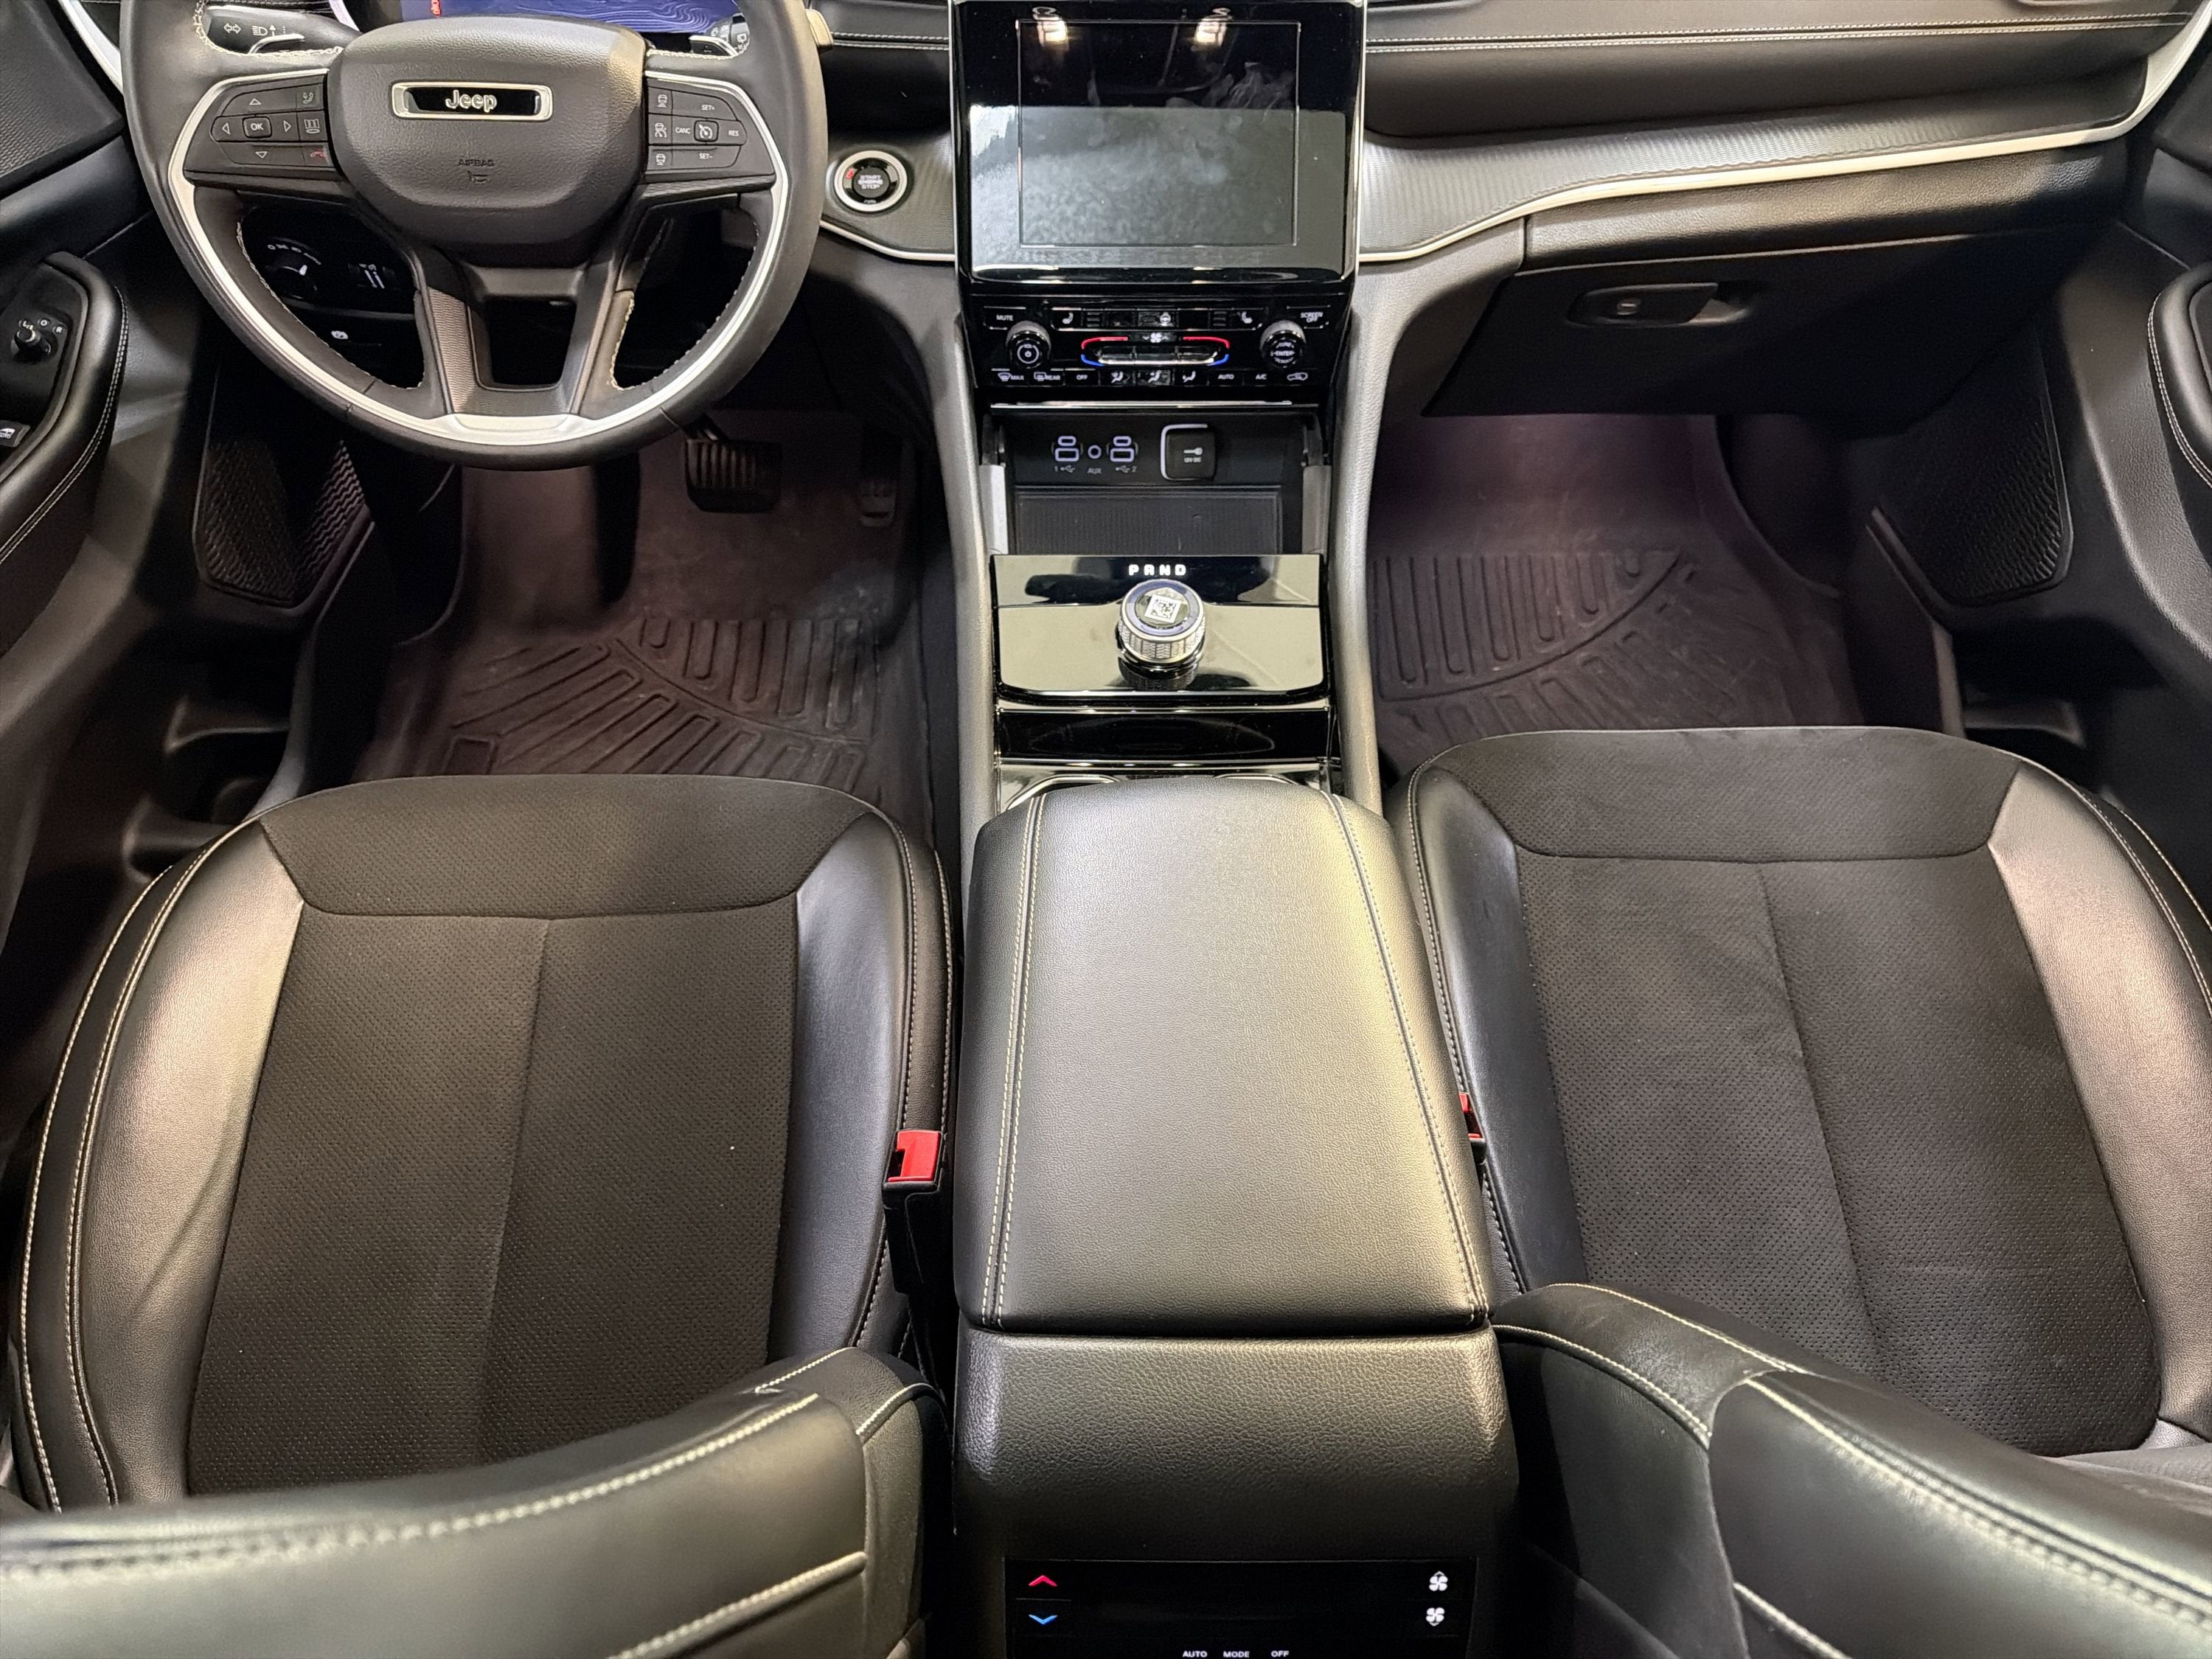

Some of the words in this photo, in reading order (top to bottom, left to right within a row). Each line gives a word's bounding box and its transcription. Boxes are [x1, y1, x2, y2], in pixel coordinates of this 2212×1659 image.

[445, 89, 497, 112] Jeep
[250, 122, 265, 131] OK
[458, 159, 495, 167] AIRBAG
[1087, 467, 1102, 475] AUX
